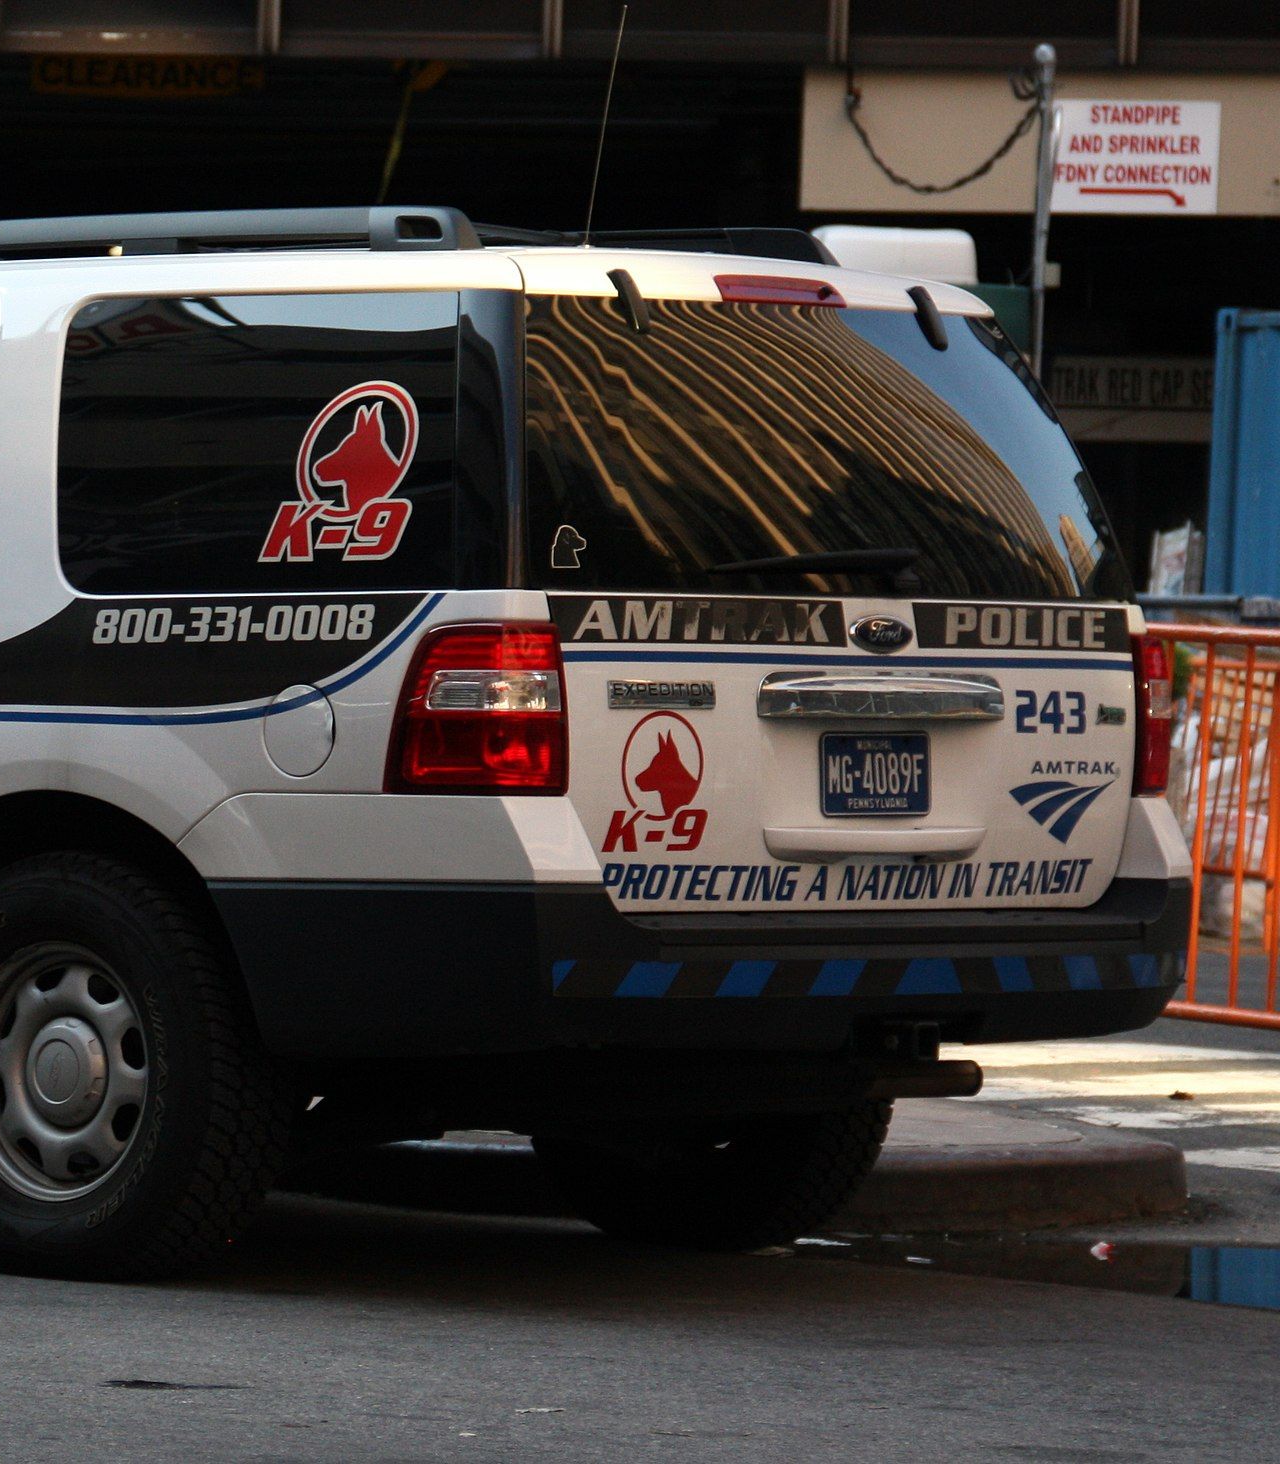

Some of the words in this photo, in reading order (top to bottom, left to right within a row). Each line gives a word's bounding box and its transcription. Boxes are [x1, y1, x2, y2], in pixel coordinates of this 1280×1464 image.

[40, 57, 261, 88] CLEARANCE
[1091, 105, 1181, 125] STANDPIPE
[1070, 135, 1102, 154] AND
[1108, 135, 1201, 155] SPRINKLER
[1055, 163, 1099, 184] FDNY
[1103, 164, 1212, 185] CONNECTION
[1053, 368, 1099, 403] TRAK
[1108, 368, 1141, 404] RED
[1150, 369, 1185, 404] CAP
[1192, 369, 1213, 405] SE
[257, 498, 413, 562] K-9
[93, 604, 375, 645] 800-331-0008
[572, 599, 831, 643] AMTRAK
[869, 619, 903, 642] Ford
[945, 605, 1107, 649] POLICE
[613, 683, 714, 697] EXPEDITION
[1015, 690, 1087, 734] 243
[828, 752, 924, 795] MG-4089F
[1031, 761, 1115, 774] AMTRAK
[848, 798, 908, 809] PENNSYLVANIA
[601, 809, 709, 852] K-9
[602, 863, 802, 901] PROTECTING
[804, 865, 827, 900] A
[837, 863, 946, 900] NATION
[947, 861, 979, 898] IN
[986, 858, 1094, 896] TRANSIT
